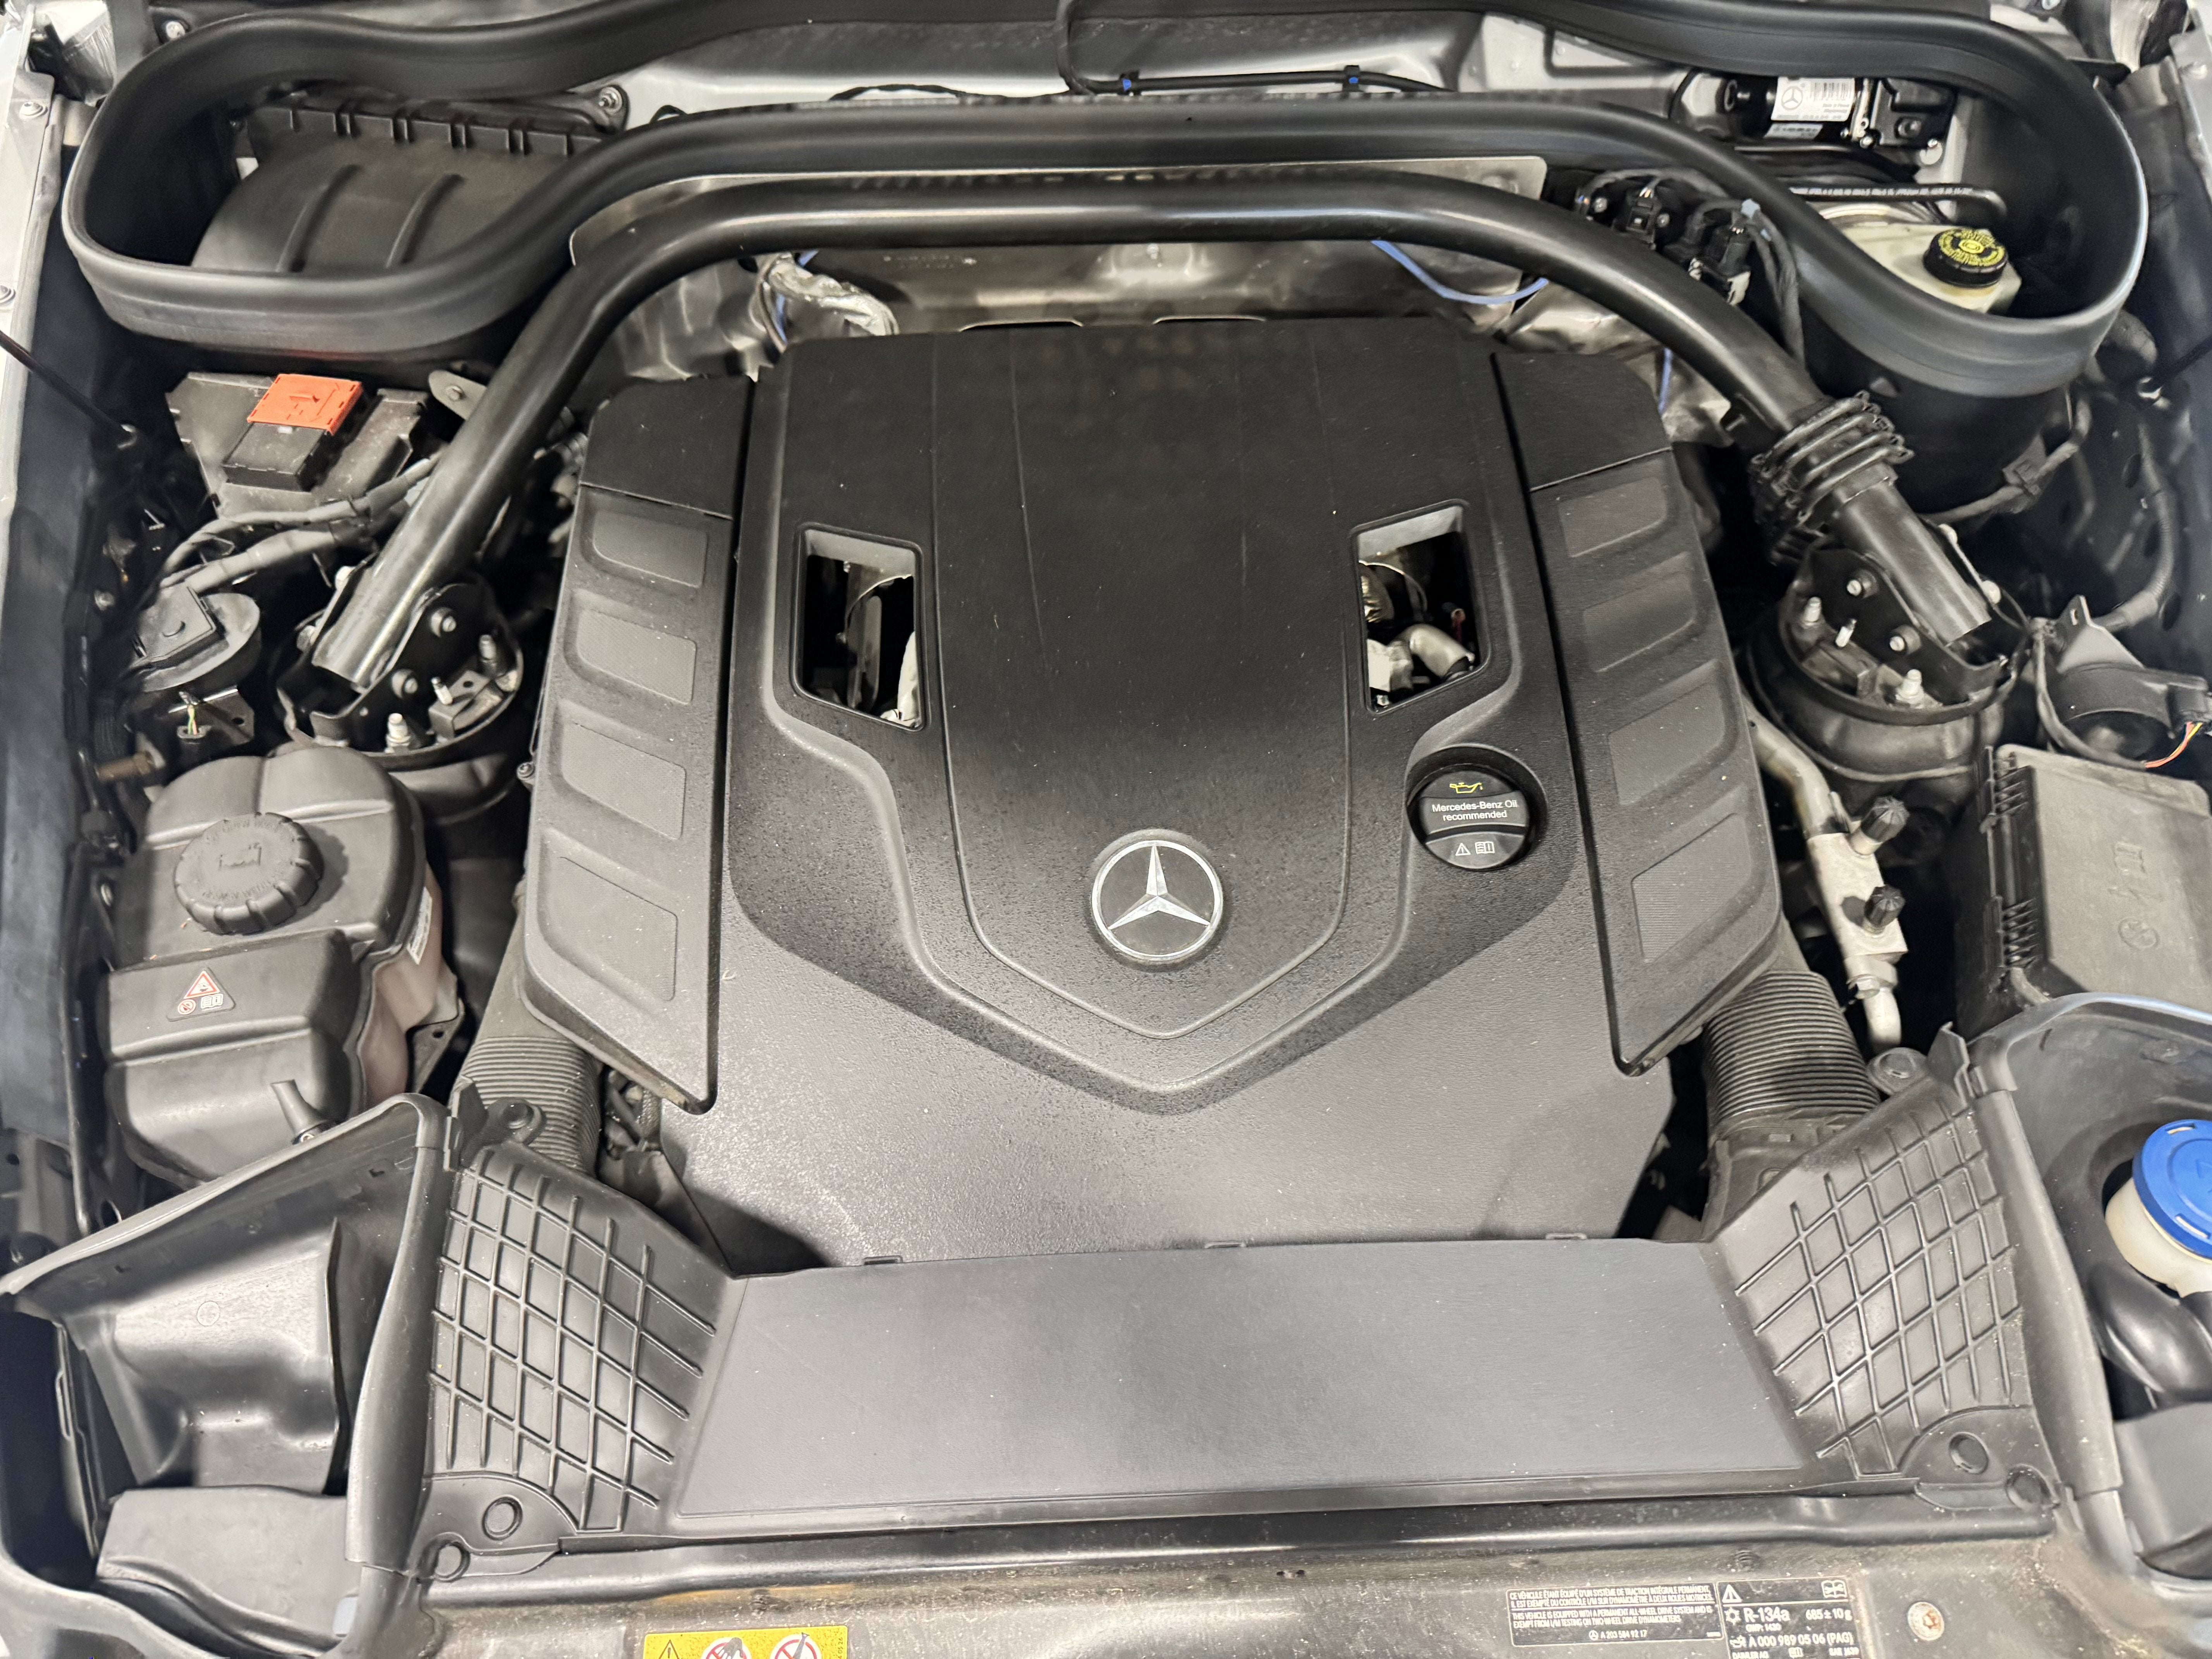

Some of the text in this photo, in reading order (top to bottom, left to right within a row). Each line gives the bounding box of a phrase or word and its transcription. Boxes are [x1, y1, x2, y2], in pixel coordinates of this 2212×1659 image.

[1432, 800, 1517, 812] Mercedes-Benz Oil
[1443, 810, 1507, 821] recommended
[1518, 1591, 1542, 1599] VÉHICULE
[1543, 1590, 1559, 1599] ÉTANT
[1593, 1588, 1616, 1597] SYSTÈME
[1625, 1587, 1650, 1595] TRACTION
[1650, 1585, 1678, 1595] INTÉGRALE
[1527, 1598, 1549, 1607] EXEMPTÉ
[1559, 1597, 1586, 1606] CONTRÔLE
[1653, 1594, 1668, 1603] DEUX
[1668, 1594, 1686, 1602] ROUES
[1525, 1611, 1546, 1620] VEHICLE
[1553, 1610, 1578, 1619] EQUIPPED
[1578, 1609, 1592, 1618] WITH
[1598, 1608, 1628, 1617] PERMANENT
[1657, 1607, 1673, 1615] DRIVE
[1673, 1606, 1694, 1614] SYSTEM
[1694, 1606, 1706, 1614] AND
[1743, 1607, 1791, 1622] R-134a
[1513, 1620, 1534, 1628] EXEMPT
[1534, 1620, 1549, 1628] FROM
[1561, 1618, 1582, 1627] TESTING
[1583, 1618, 1591, 1626] ON
[1622, 1616, 1638, 1625] DRIVE
[1749, 1632, 1854, 1647] A 000 989 05 06 (PAG)
